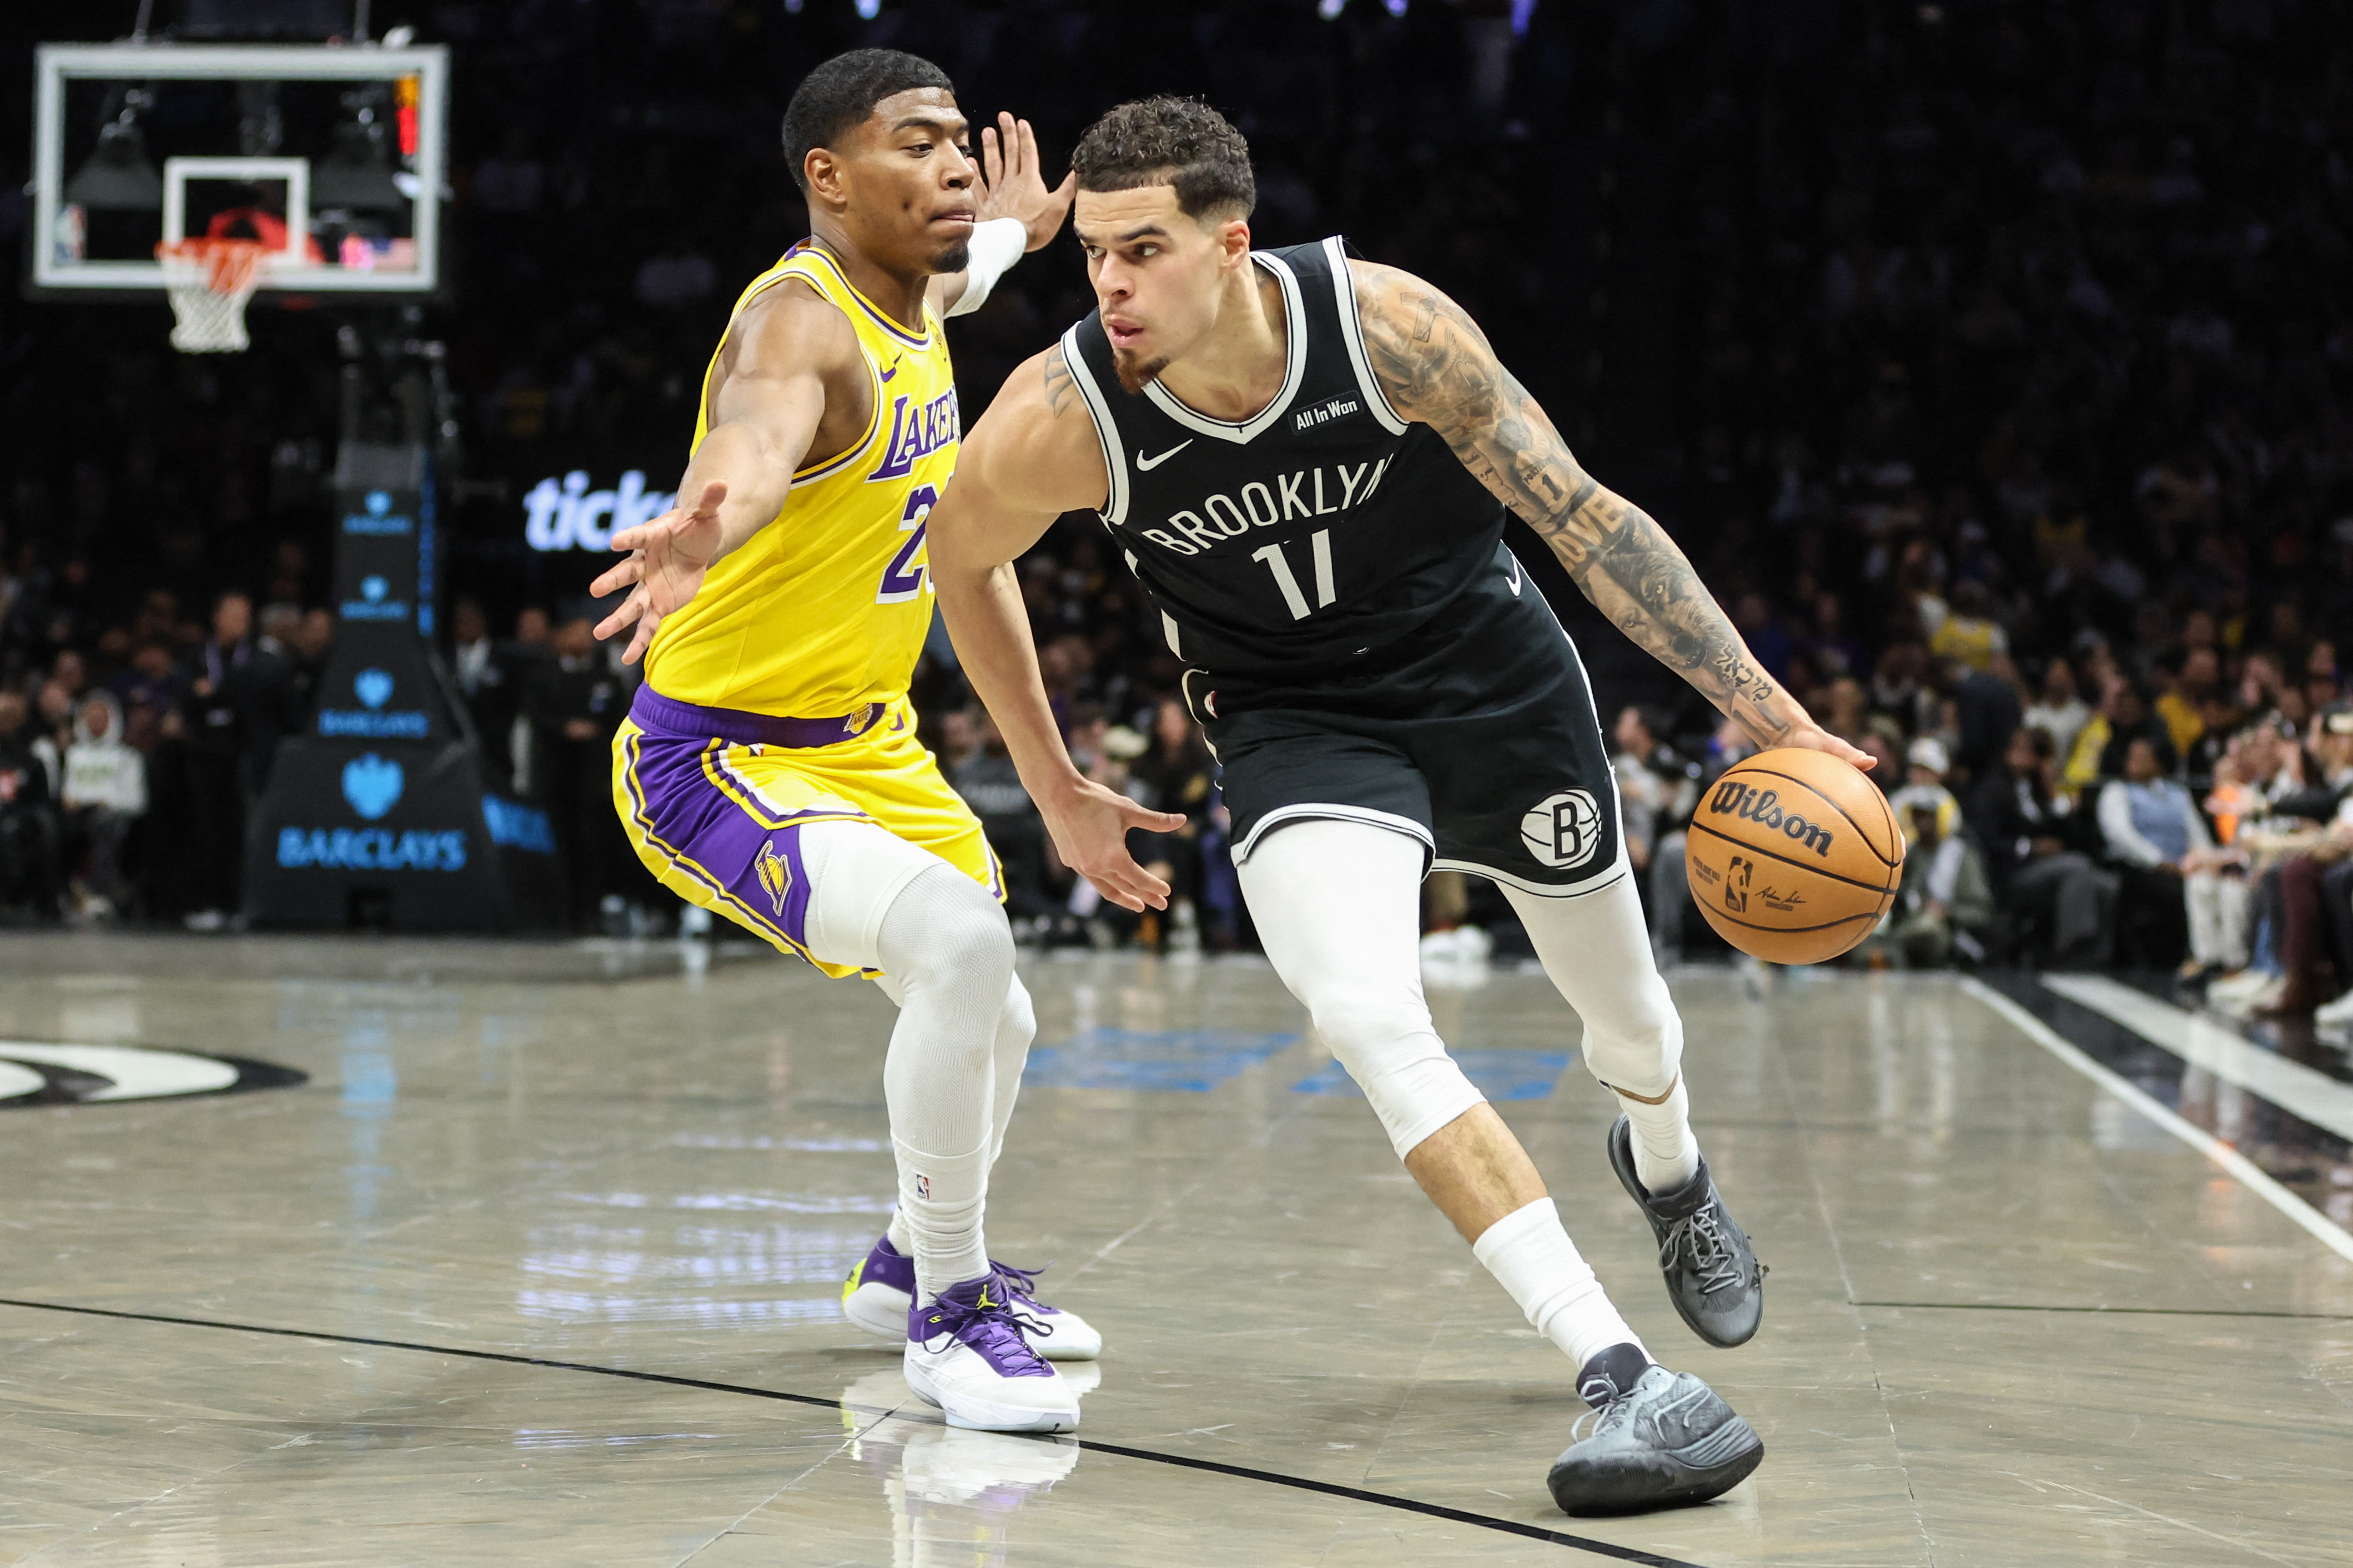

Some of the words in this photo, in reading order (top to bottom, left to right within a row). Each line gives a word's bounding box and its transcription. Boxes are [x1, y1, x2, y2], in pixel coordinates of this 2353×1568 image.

[864, 382, 961, 483] LAKER
[1296, 414, 1314, 431] All
[1313, 407, 1329, 423] In
[1326, 400, 1358, 418] Won
[523, 471, 678, 551] tick
[1542, 473, 1564, 502] 1
[875, 472, 954, 604] 2
[276, 826, 467, 872] BARCLAYS
[1553, 801, 1581, 860] B
[1710, 782, 1834, 858] Wilson
